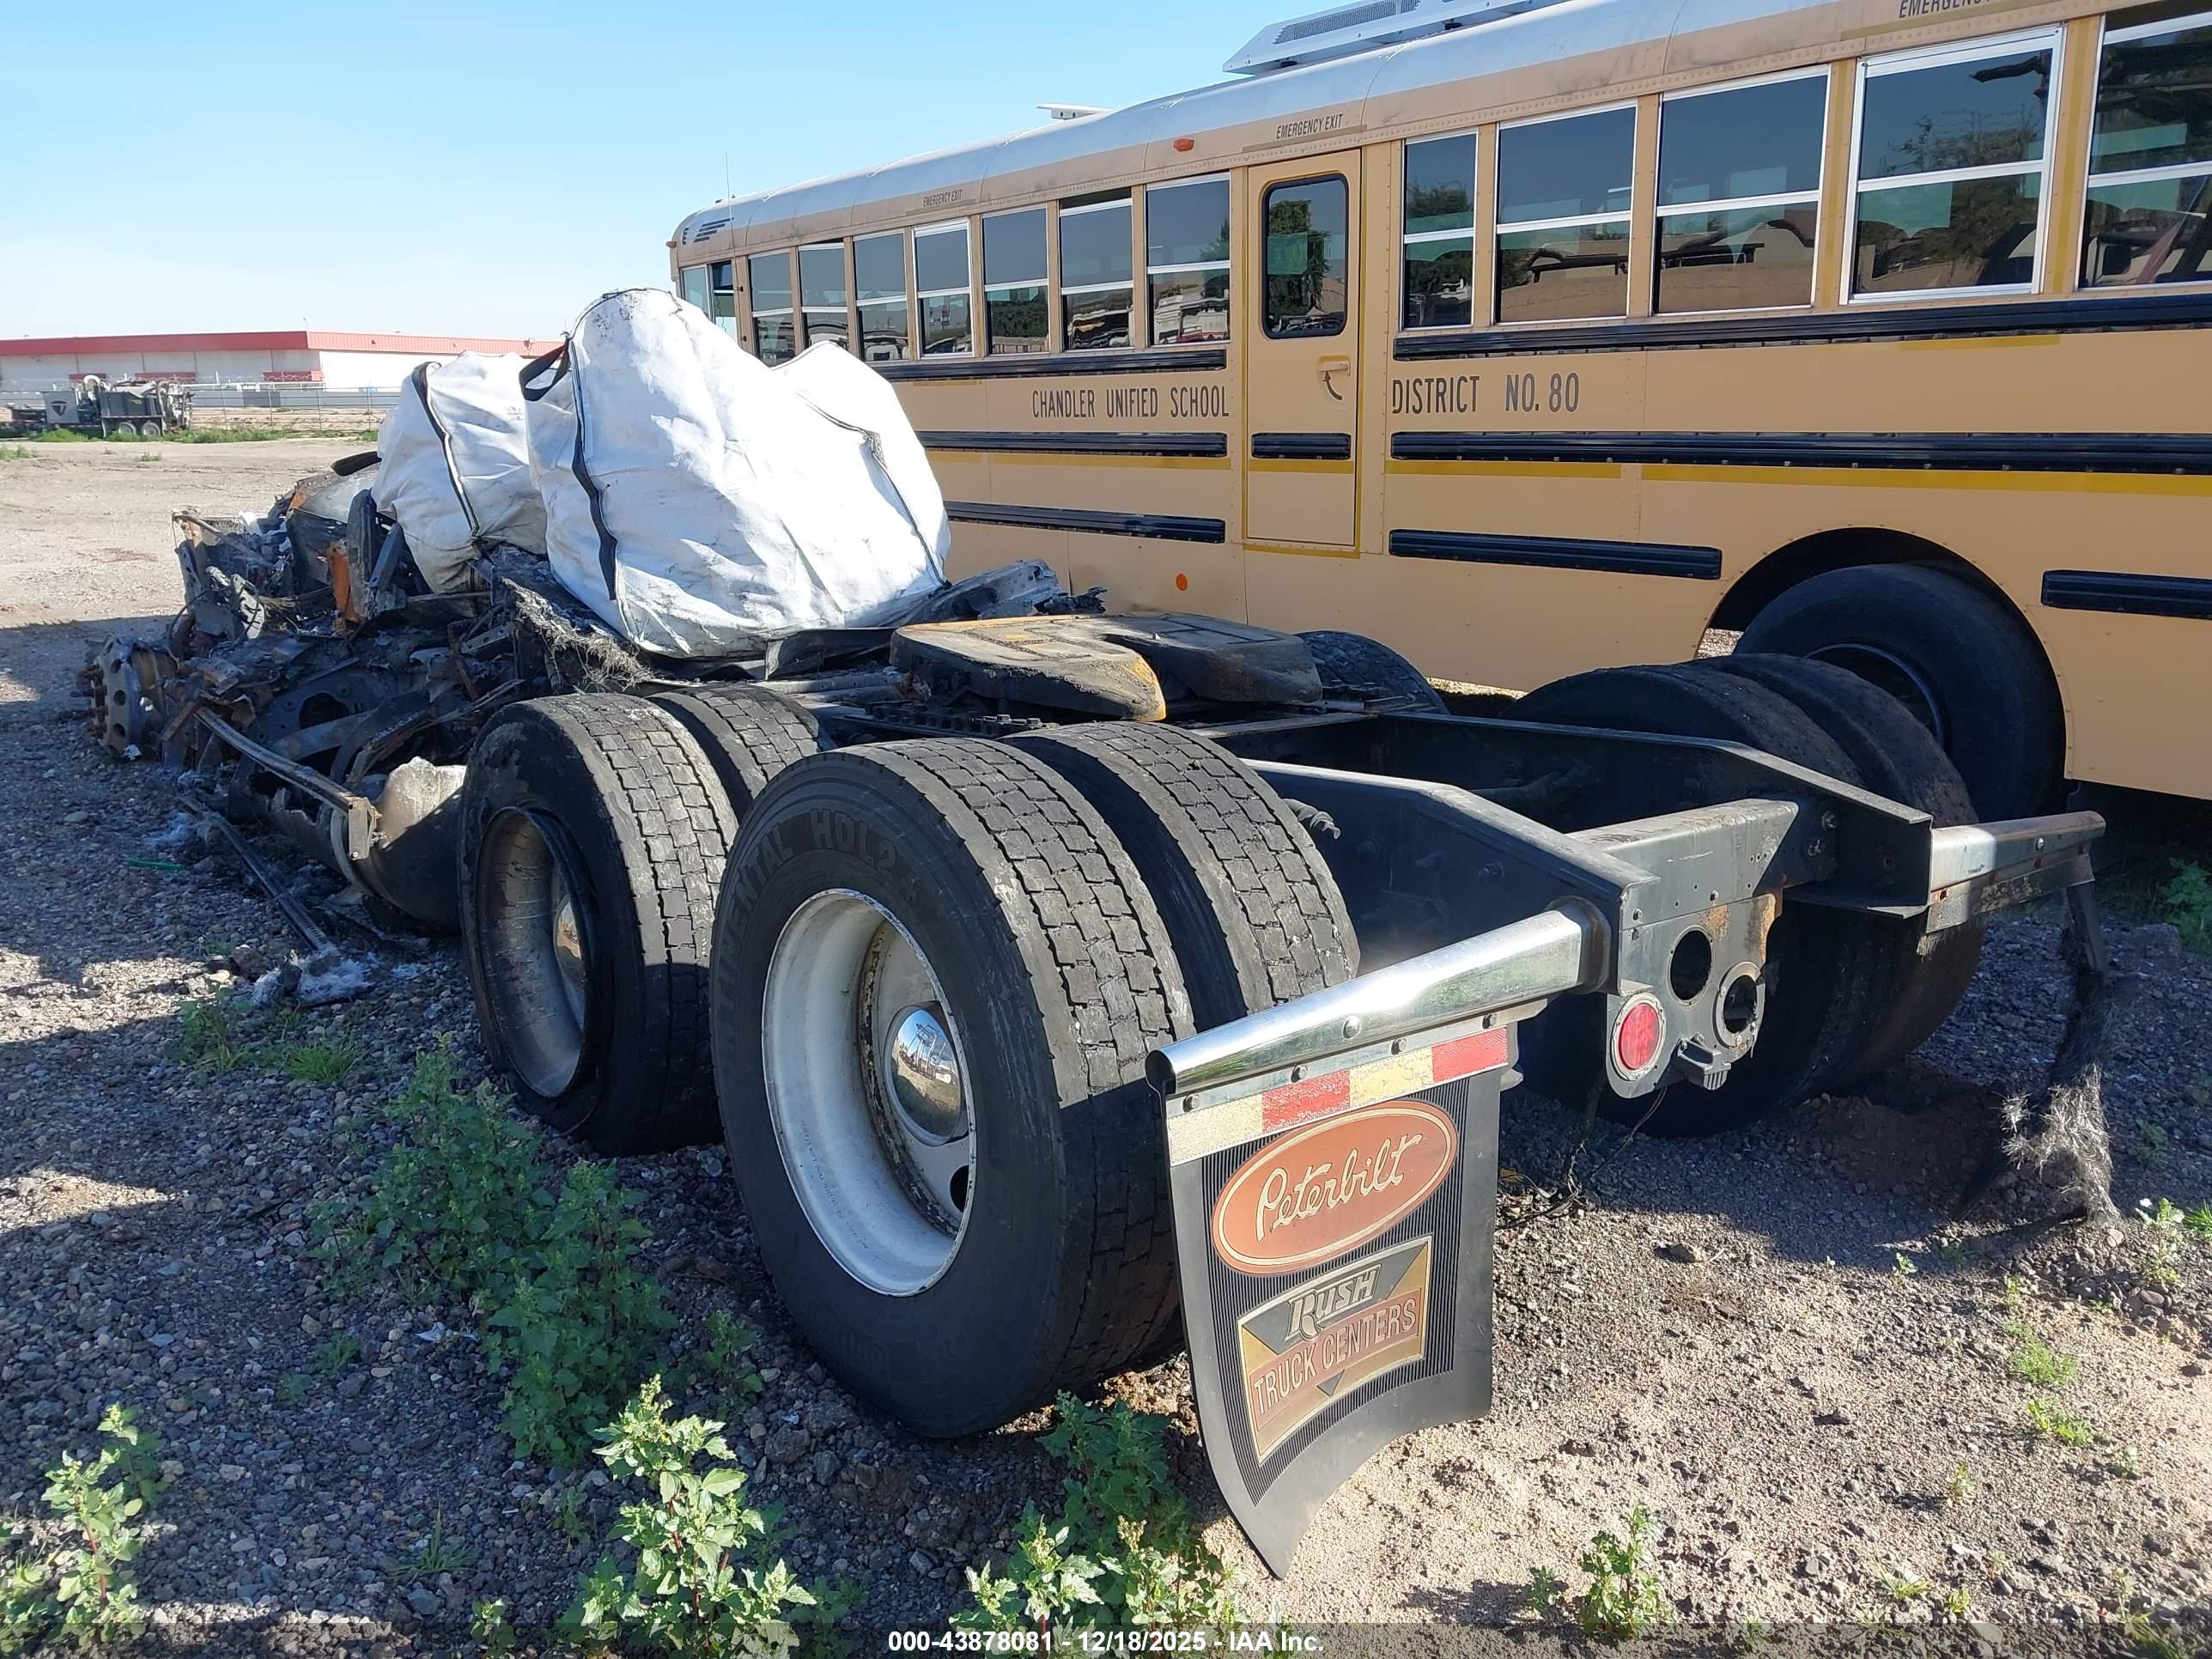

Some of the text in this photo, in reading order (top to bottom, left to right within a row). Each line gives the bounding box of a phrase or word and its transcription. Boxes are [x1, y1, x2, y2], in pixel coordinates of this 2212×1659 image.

[1276, 113, 1344, 139] EMERGENCY EXIT
[951, 189, 963, 202] EXIT
[1032, 372, 1580, 418] CHANDLER UNIFIED SCHOOL DISTRICT NO. 80
[1255, 1133, 1424, 1243] Peterbilt
[1254, 1298, 1417, 1415] TRUCK CENTERS
